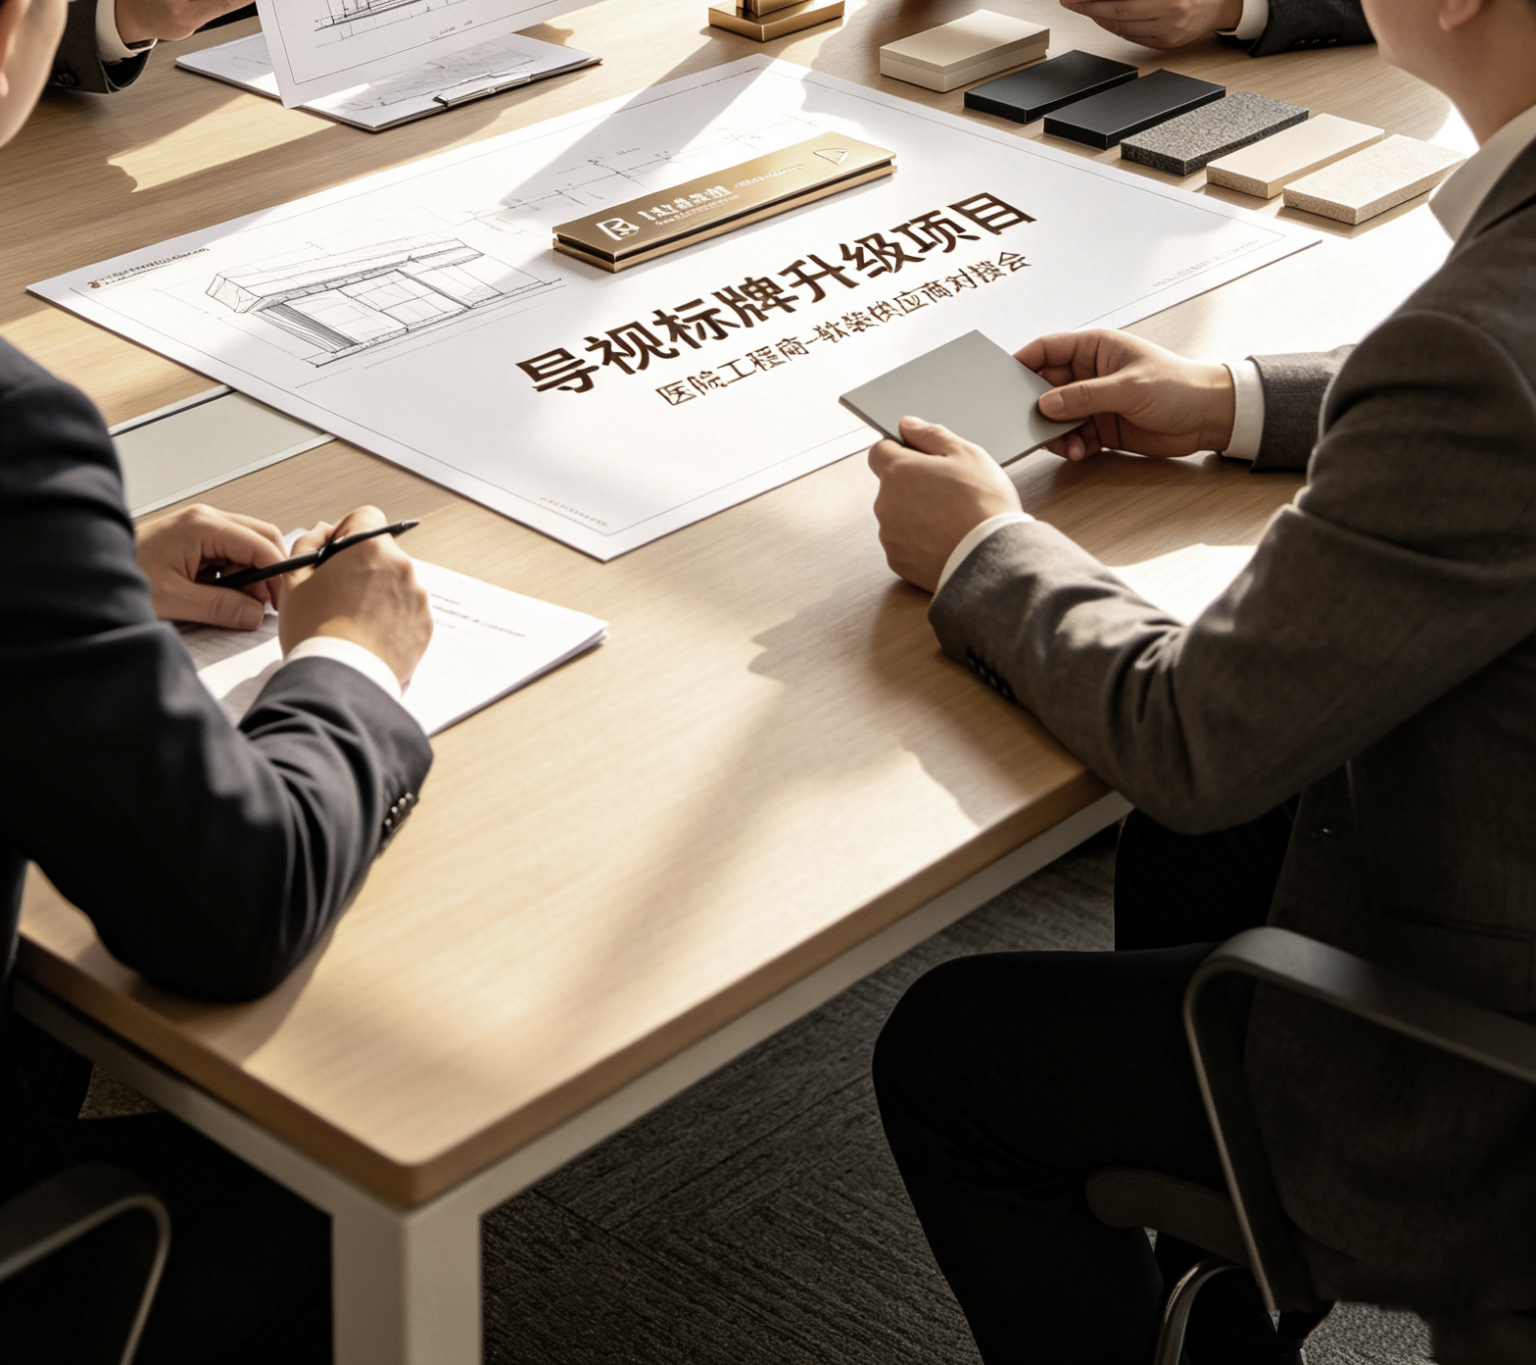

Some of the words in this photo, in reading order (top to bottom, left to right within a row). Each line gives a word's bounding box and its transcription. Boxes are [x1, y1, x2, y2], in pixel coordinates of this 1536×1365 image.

[516, 193, 1036, 393] 导视标牌升级项目
